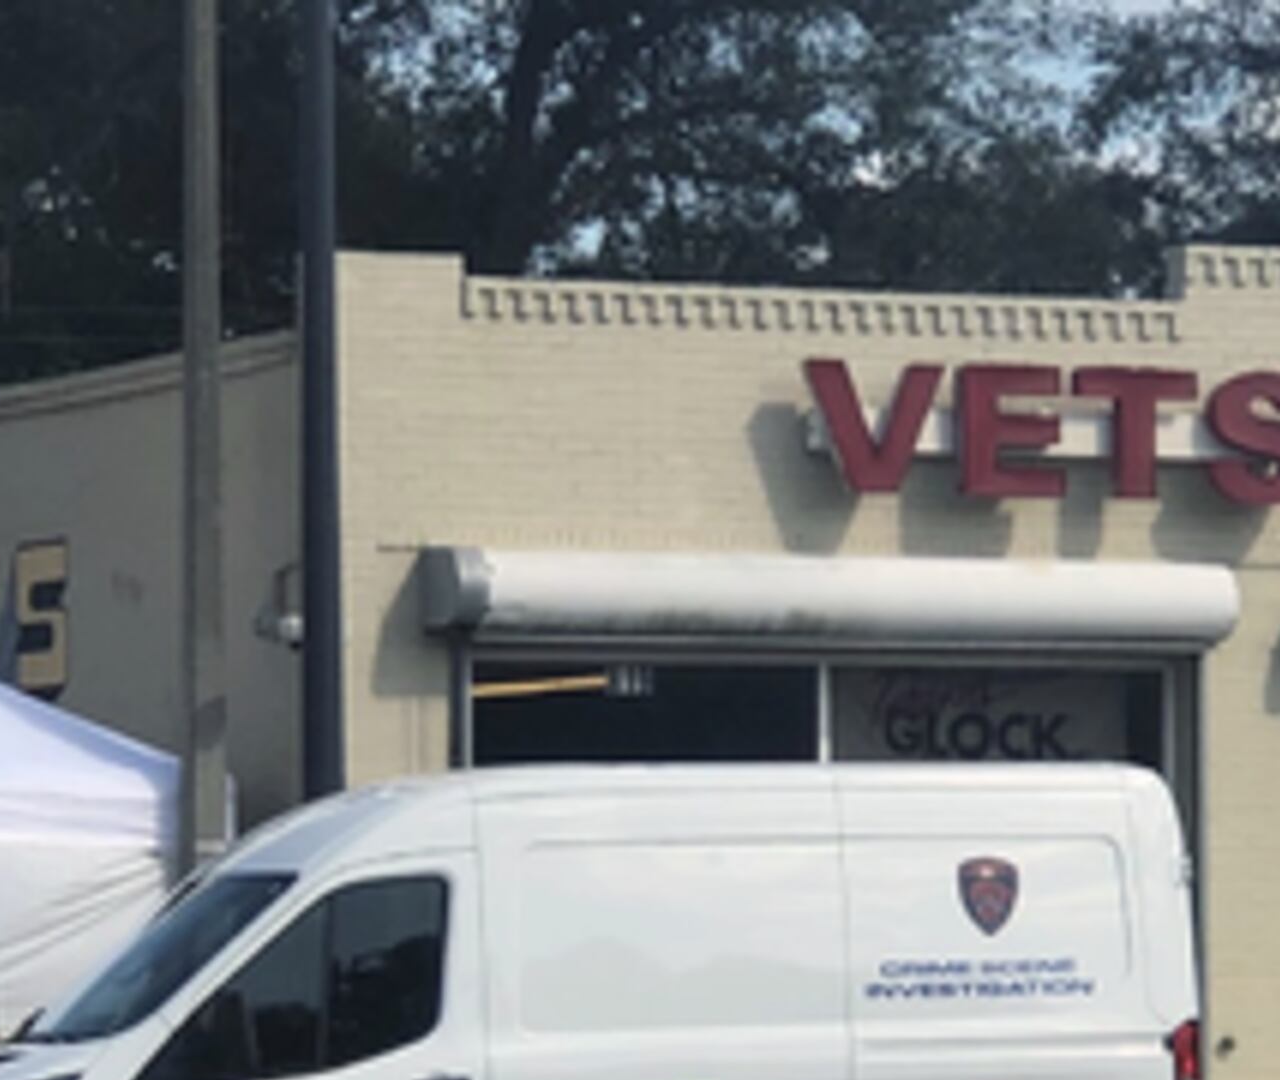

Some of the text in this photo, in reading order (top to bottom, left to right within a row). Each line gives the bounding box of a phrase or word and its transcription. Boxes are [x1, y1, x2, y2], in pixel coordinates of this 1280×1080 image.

[884, 711, 1073, 761] GLOCK
[879, 956, 1077, 977] CRIME SCENE
[864, 977, 1095, 999] INVESTIGATION
